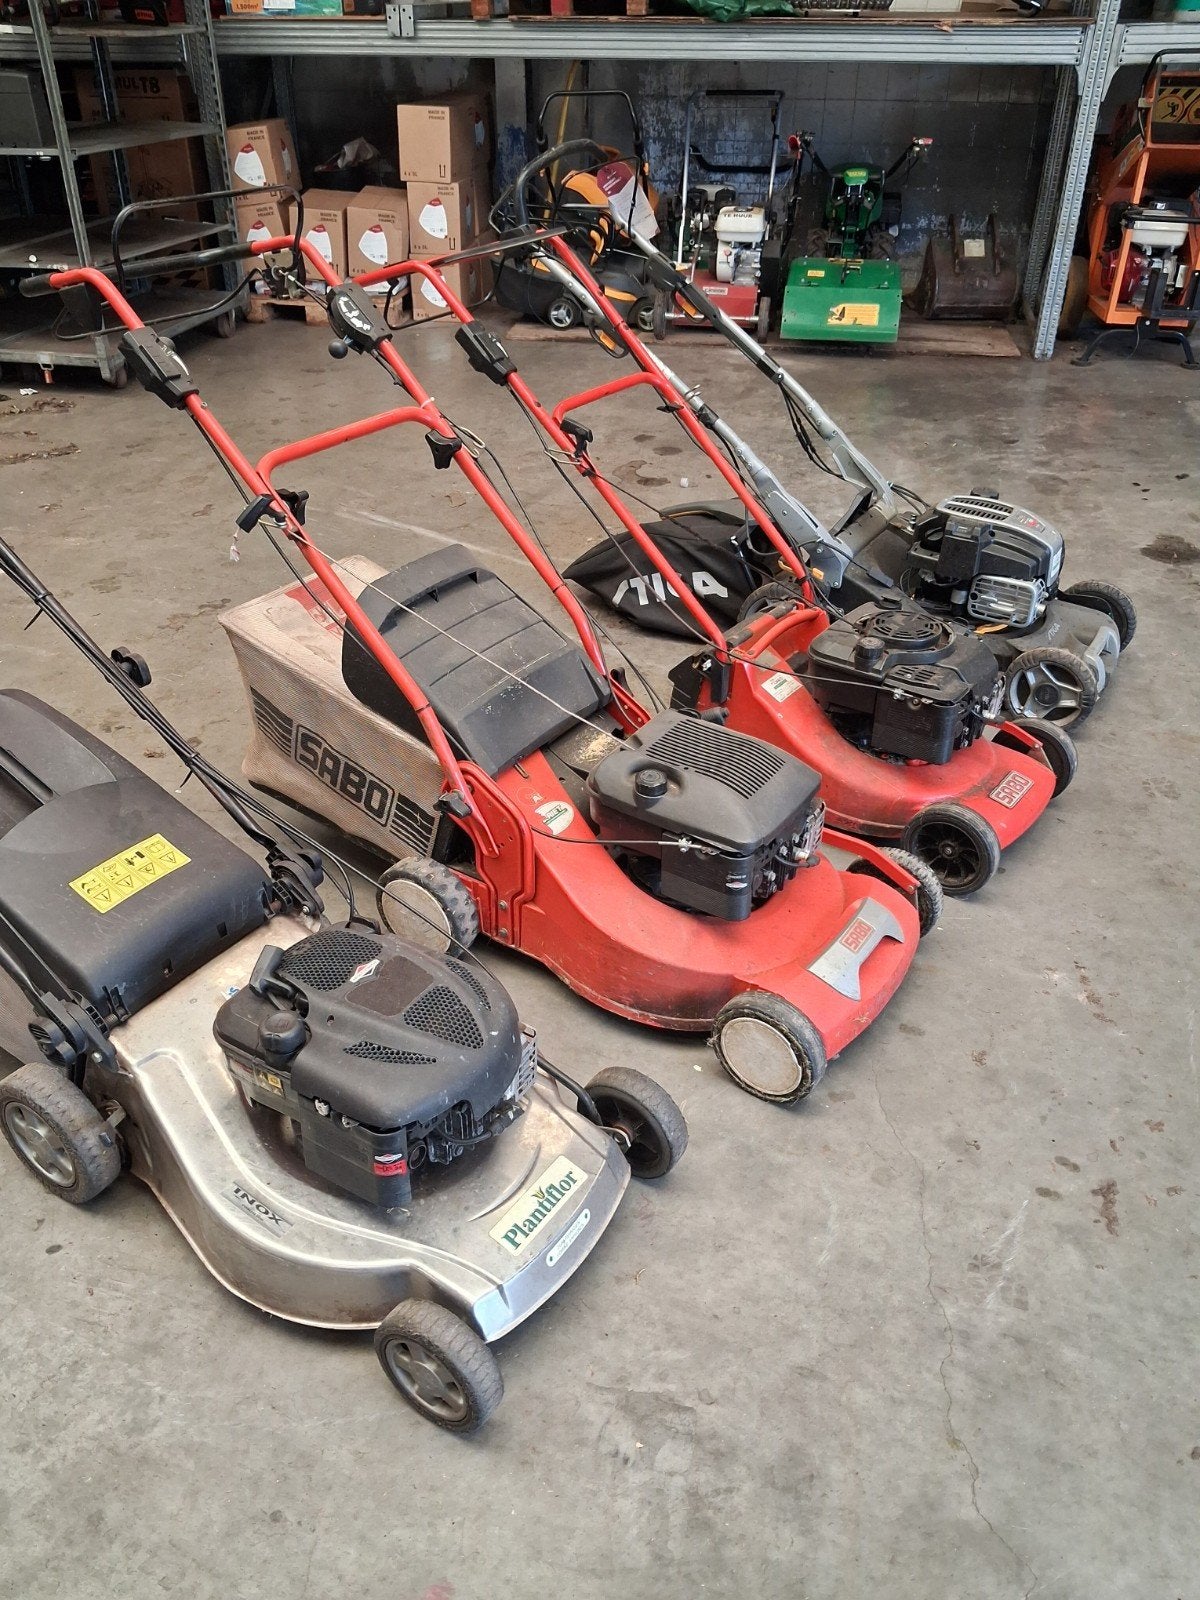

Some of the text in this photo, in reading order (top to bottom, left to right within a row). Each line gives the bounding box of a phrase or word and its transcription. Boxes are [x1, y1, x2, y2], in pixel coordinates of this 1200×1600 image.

[300, 732, 389, 820] SABO
[994, 774, 1030, 804] SABO
[843, 919, 873, 950] SABO
[233, 1187, 283, 1226] INOX
[501, 1170, 577, 1250] Plantiflor
